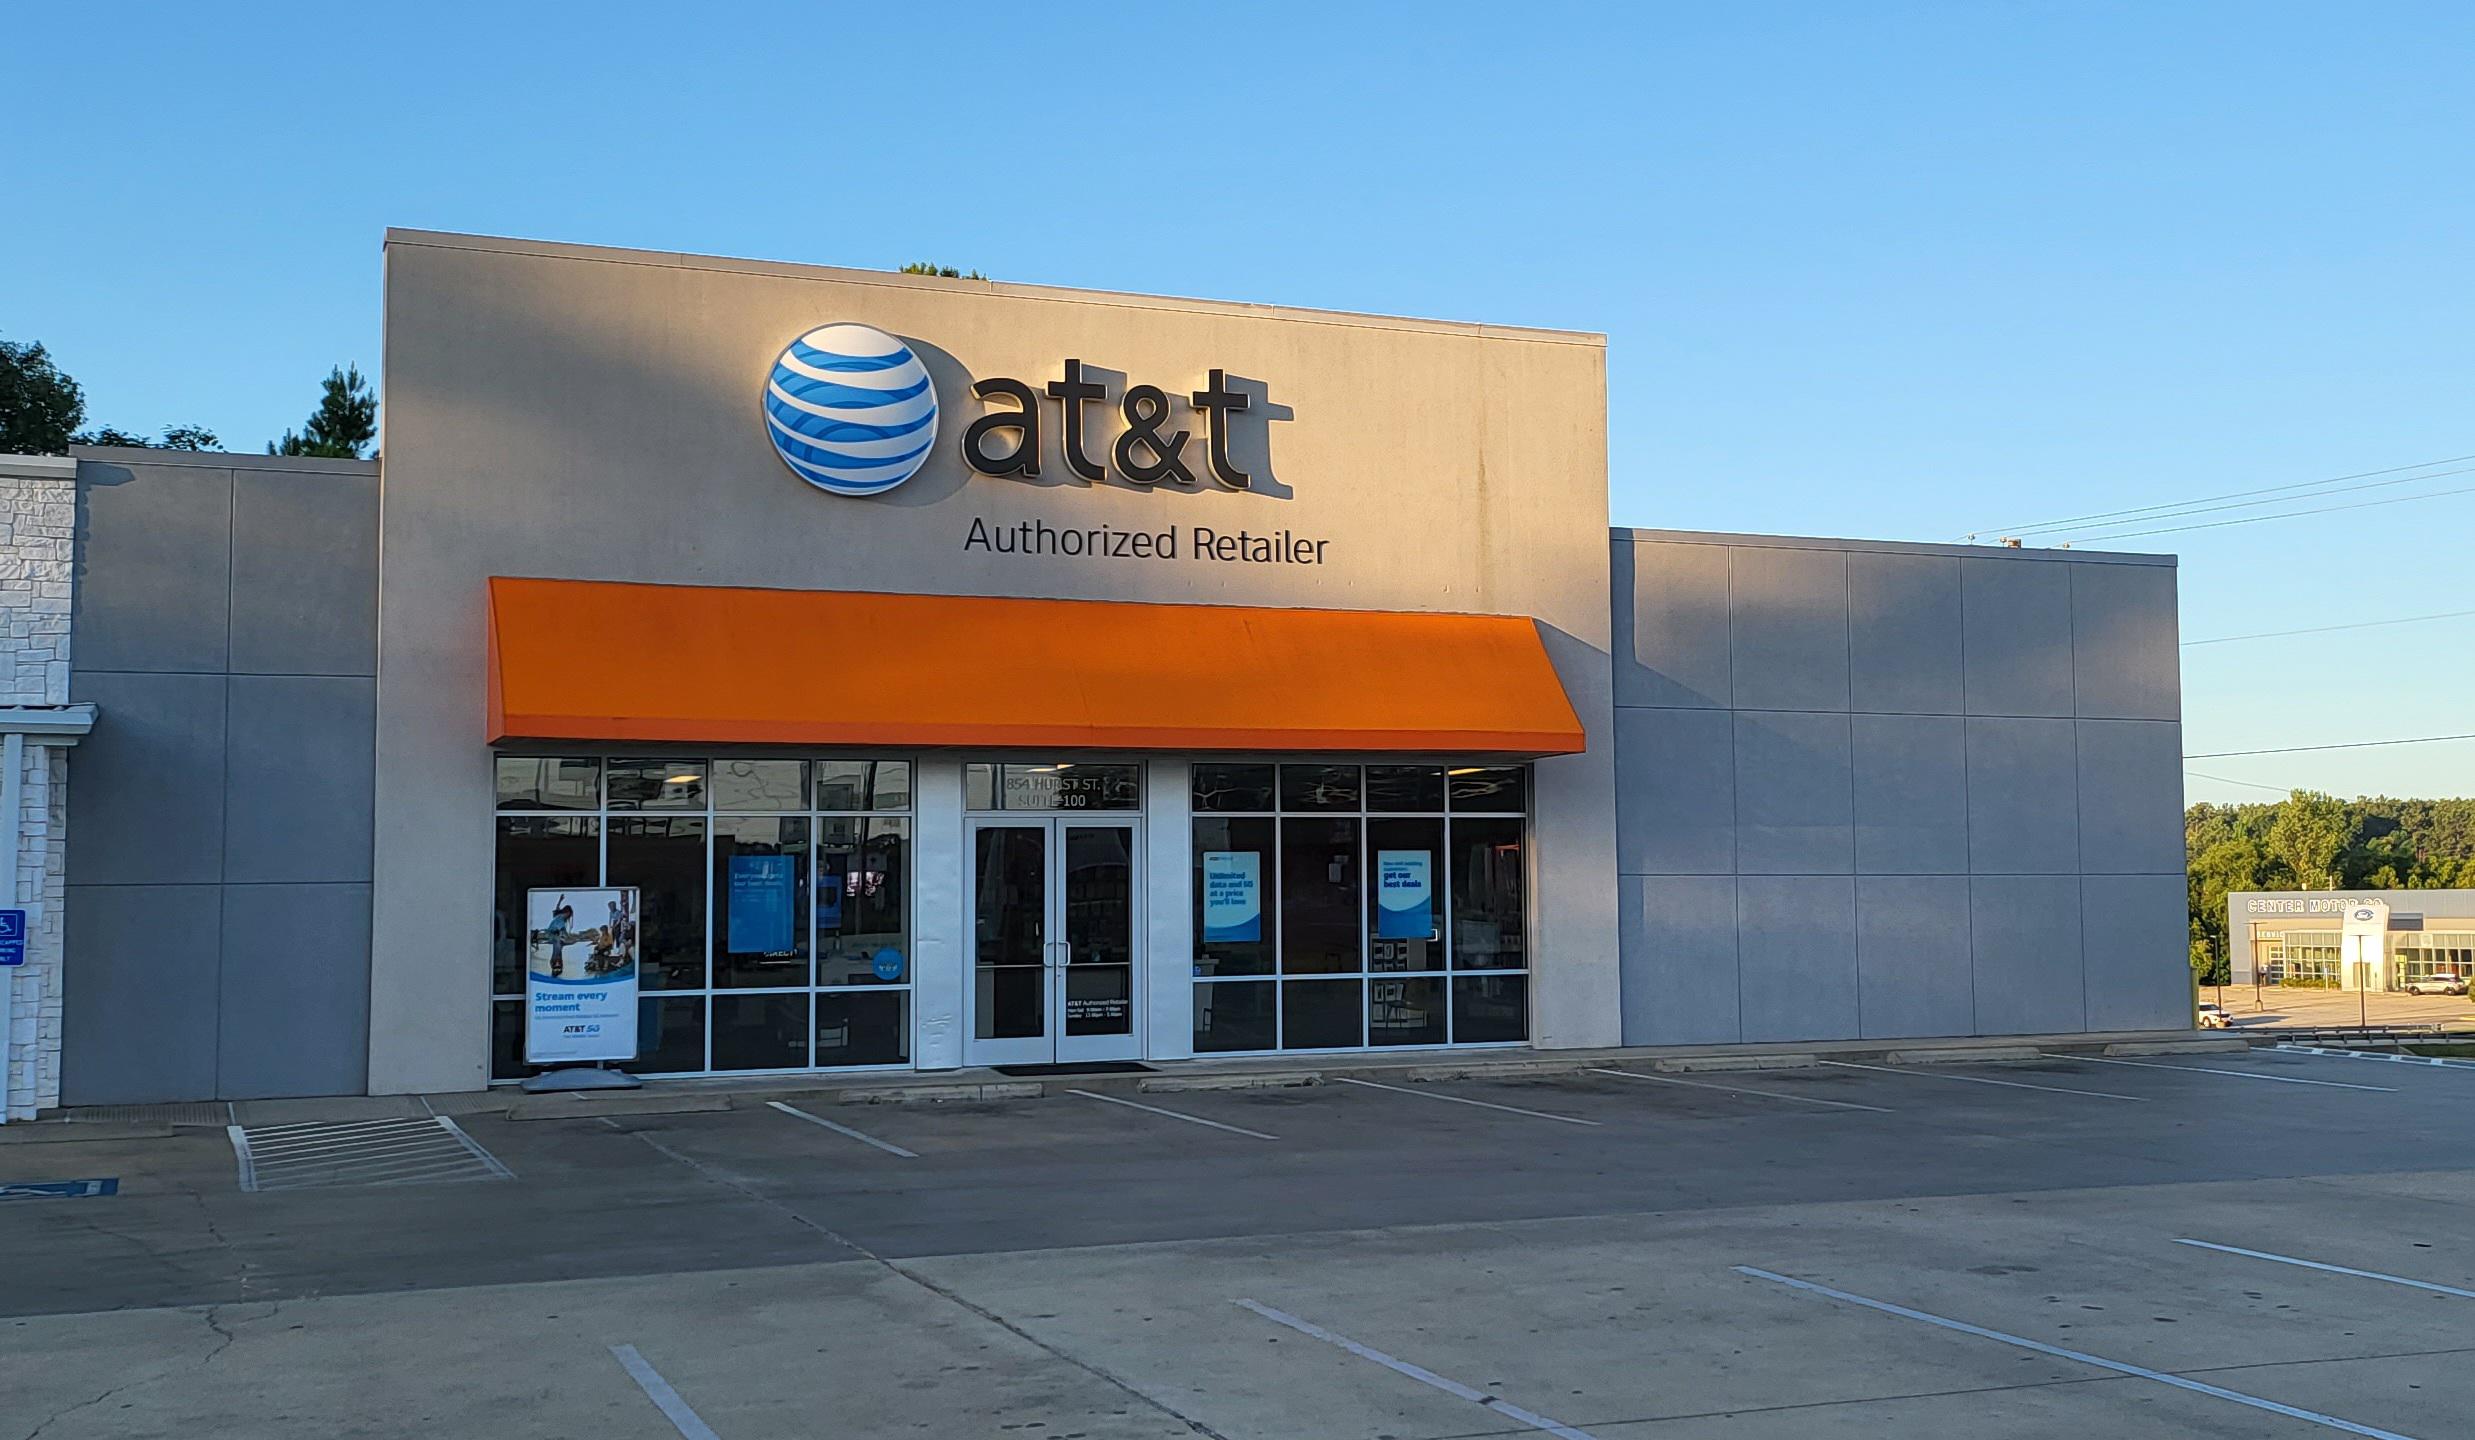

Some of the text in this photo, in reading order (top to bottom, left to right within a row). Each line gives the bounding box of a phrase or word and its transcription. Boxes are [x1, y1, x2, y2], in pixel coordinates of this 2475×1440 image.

[961, 359, 1251, 489] at&t
[964, 517, 1330, 565] Authorized Retailer
[1007, 777, 1101, 790] 854 HURST ST.
[1063, 794, 1086, 807] 100
[1209, 871, 1246, 879] Unlimited
[1383, 872, 1397, 881] get
[1228, 880, 1242, 888] and
[1383, 880, 1422, 888] best deals
[1225, 889, 1244, 899] price
[1209, 898, 1230, 908] you'll
[2247, 899, 2305, 913] CENTER
[535, 991, 608, 1001] Stream every
[534, 1003, 581, 1013] moment
[563, 1025, 601, 1033] AT&T 5G
